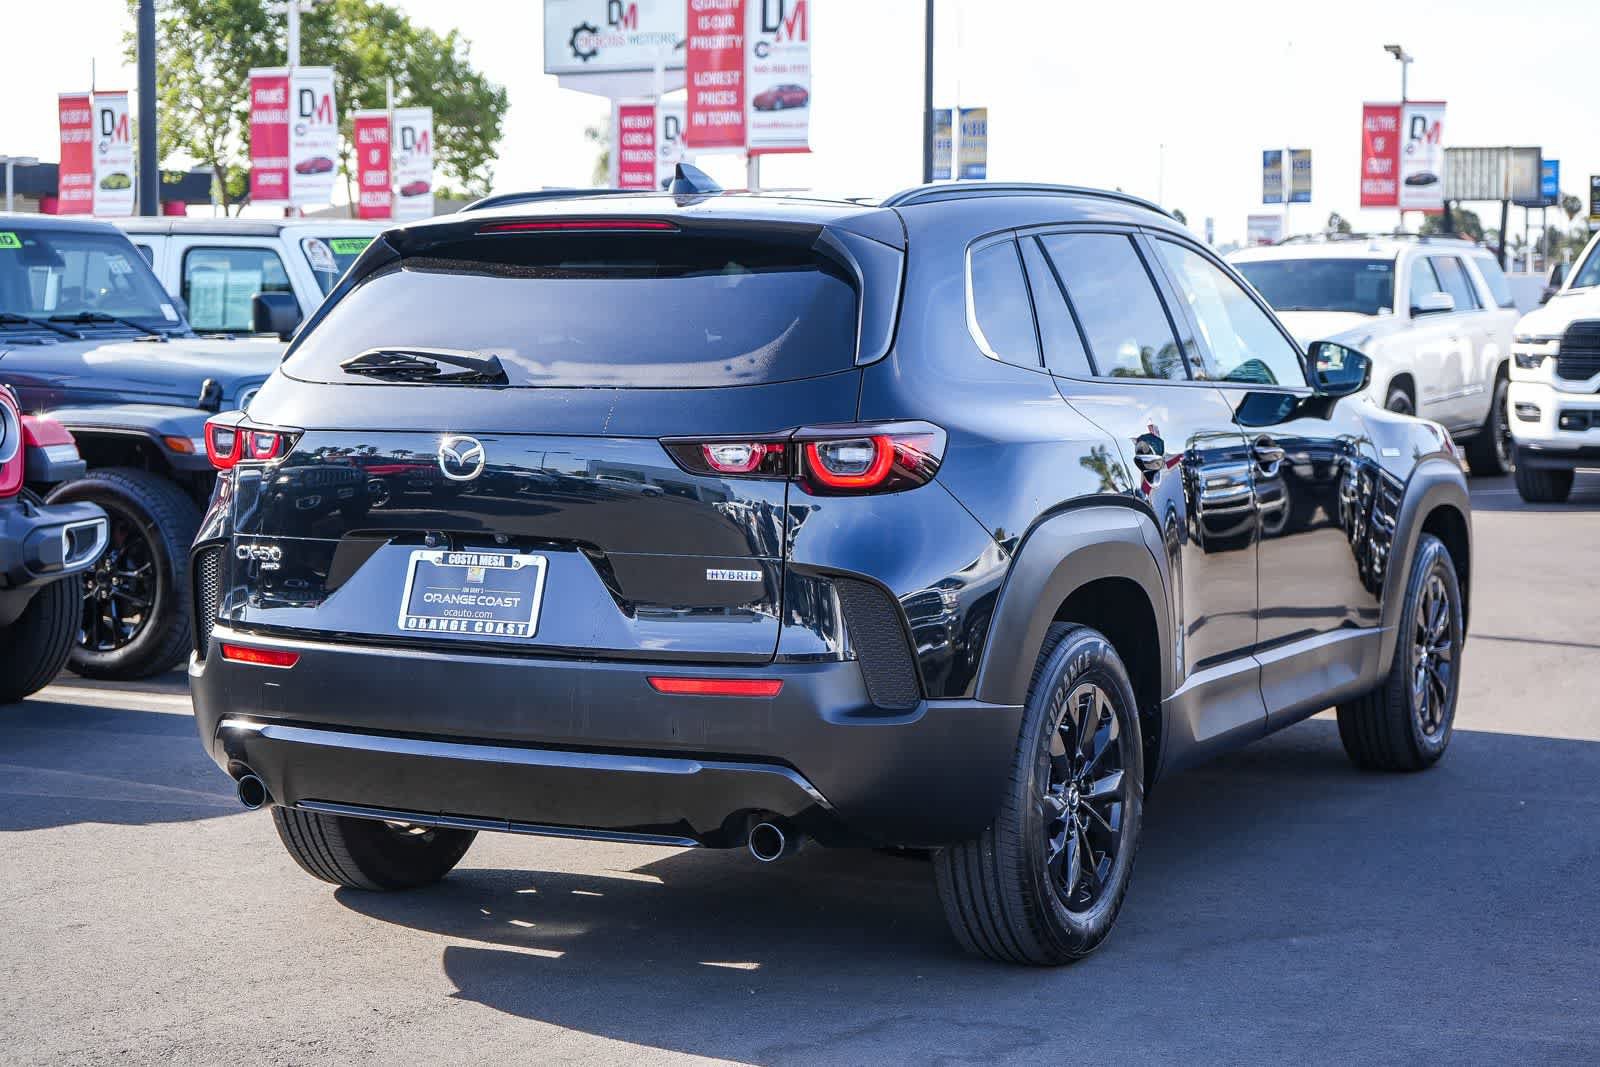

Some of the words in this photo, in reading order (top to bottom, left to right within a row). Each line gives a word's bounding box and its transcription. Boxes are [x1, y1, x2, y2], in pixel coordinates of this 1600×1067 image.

[690, 35, 743, 49] PRIORITY
[694, 71, 740, 87] LOWEST
[697, 90, 738, 105] PRICES
[236, 544, 282, 561] CX-50
[448, 553, 479, 566] COSTA
[479, 555, 506, 567] MESA
[710, 569, 760, 581] HYBRID
[423, 592, 477, 606] ORANGE
[477, 595, 521, 608] COAST
[443, 607, 494, 619] ocauto.com
[408, 617, 469, 632] ORANGE
[474, 622, 527, 635] COAST
